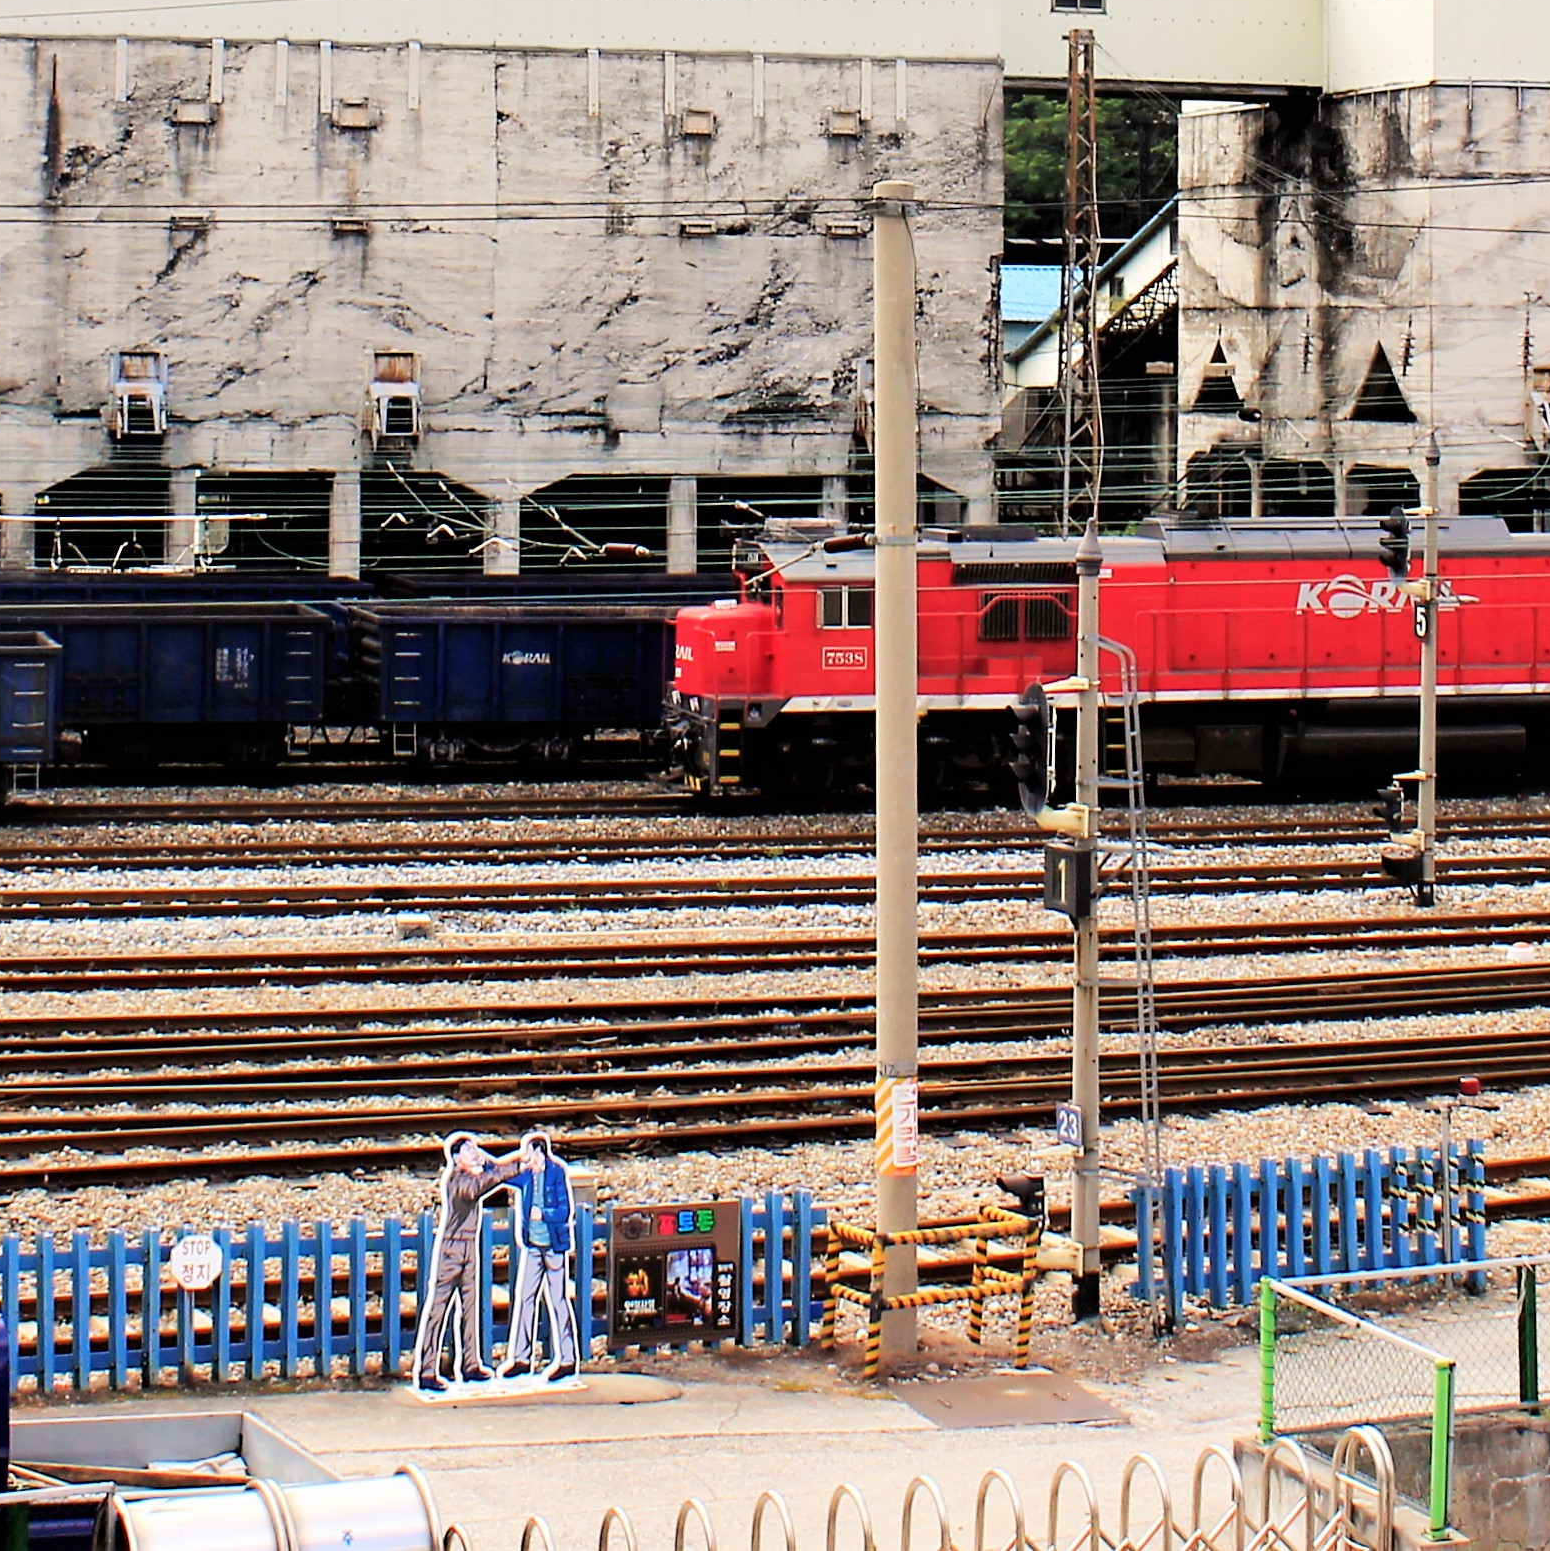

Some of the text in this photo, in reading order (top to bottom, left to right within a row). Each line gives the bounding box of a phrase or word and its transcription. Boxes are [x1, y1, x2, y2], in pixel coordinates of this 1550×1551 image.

[1416, 606, 1428, 637] 5
[502, 650, 550, 665] KORAIL
[826, 652, 865, 666] 7538
[1059, 1109, 1079, 1140] 23
[182, 1239, 211, 1256] STOP
[182, 1262, 211, 1283] 정지
